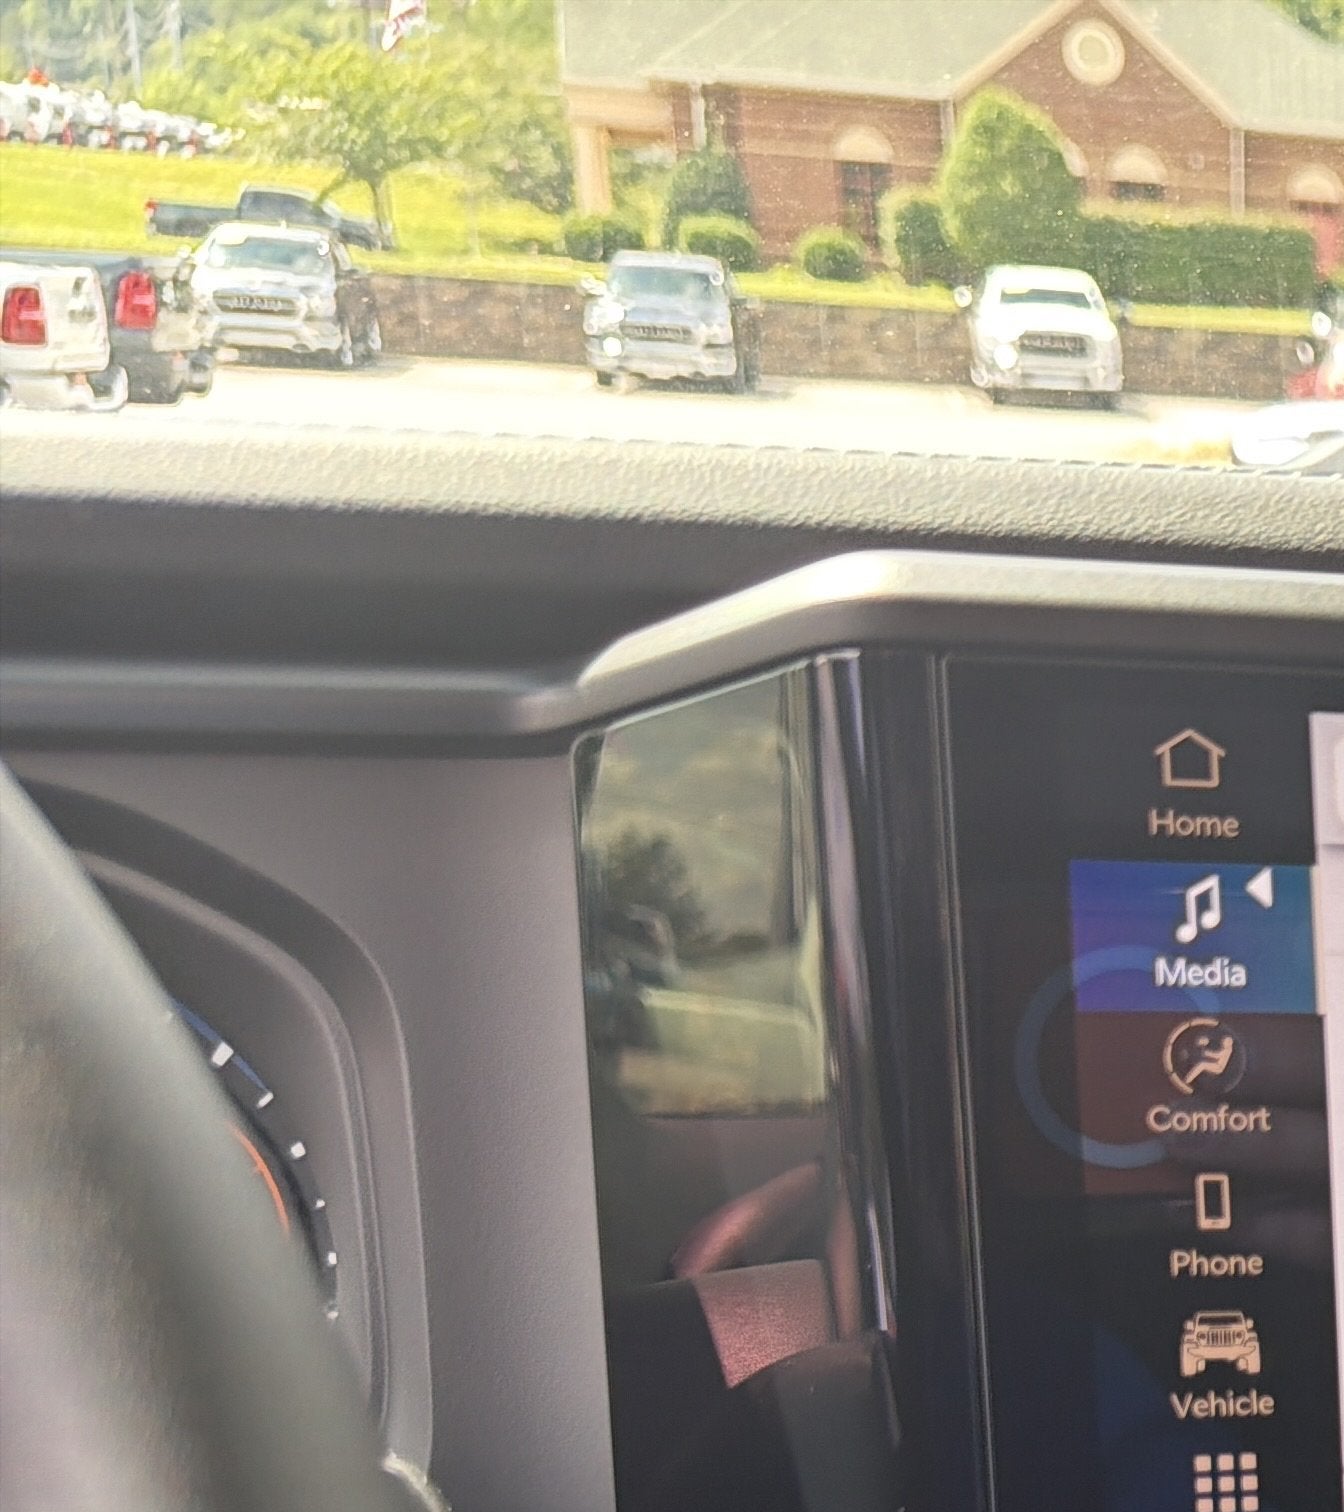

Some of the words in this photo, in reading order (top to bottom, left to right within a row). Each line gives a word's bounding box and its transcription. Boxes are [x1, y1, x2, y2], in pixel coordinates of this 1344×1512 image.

[1149, 809, 1240, 838] Home
[1155, 959, 1247, 987] Media
[1146, 1106, 1271, 1133] Comfort
[1170, 1250, 1263, 1277] Phone
[1171, 1392, 1275, 1418] Vehicle
